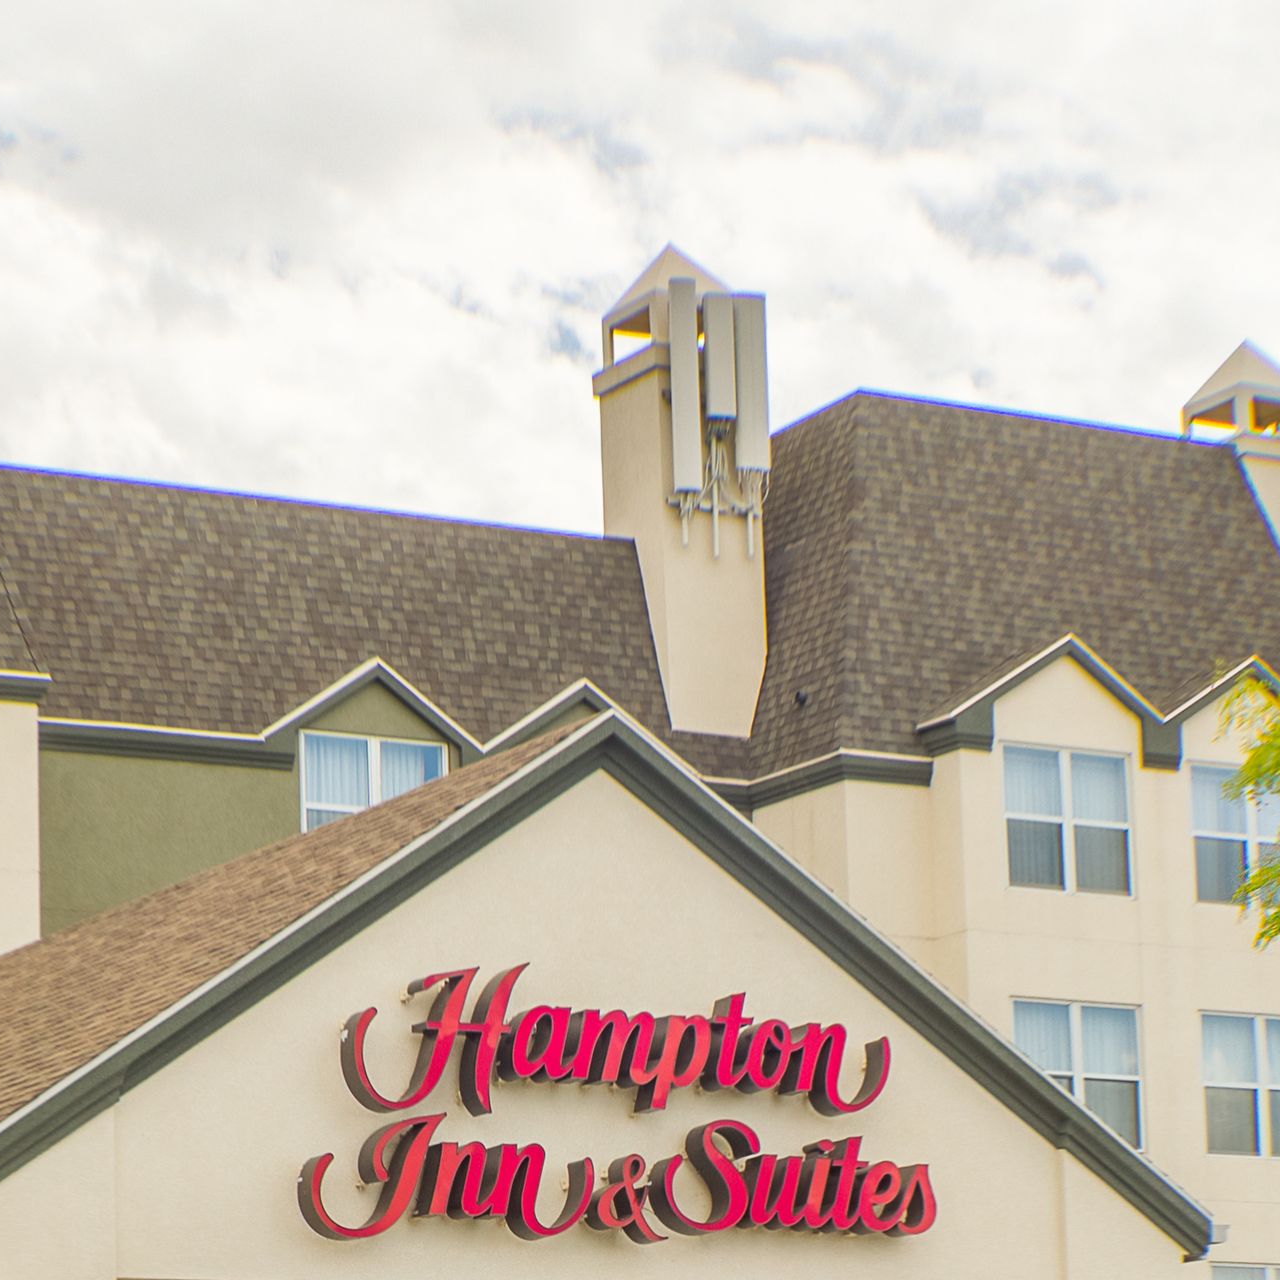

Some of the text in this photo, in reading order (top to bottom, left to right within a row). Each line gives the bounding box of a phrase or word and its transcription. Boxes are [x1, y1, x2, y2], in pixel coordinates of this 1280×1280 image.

[340, 963, 890, 1115] Hampton
[298, 1112, 937, 1244] Inn & Suites
